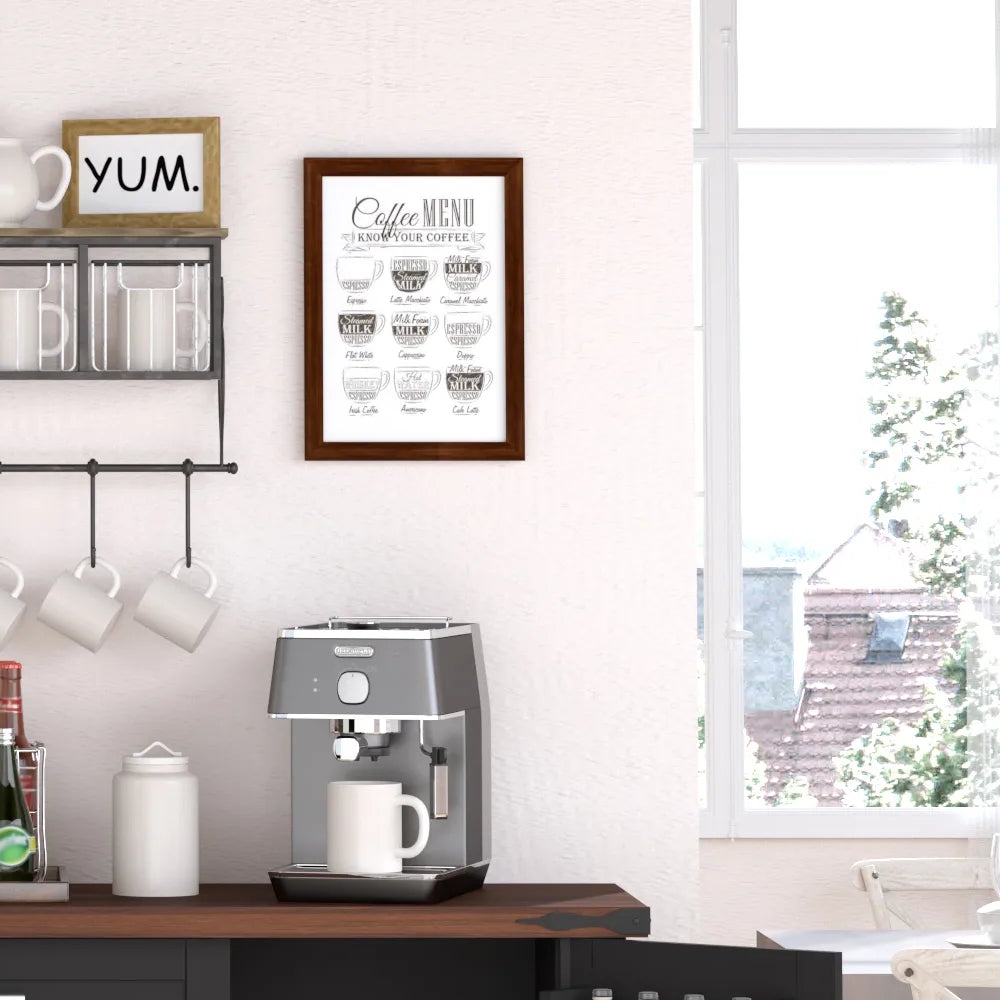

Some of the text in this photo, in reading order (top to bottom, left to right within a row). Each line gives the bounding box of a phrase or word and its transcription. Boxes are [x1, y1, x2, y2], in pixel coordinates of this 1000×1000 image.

[84, 155, 200, 193] YUM.
[352, 196, 475, 239] Coffee MENU
[358, 232, 470, 242] KNOW YOUR COFFEE
[448, 264, 478, 274] MILK
[396, 280, 424, 291] MILK
[394, 313, 411, 324] Milk
[342, 324, 372, 334] MILK
[395, 326, 426, 336] MILK
[447, 323, 481, 335] ESPRESSO
[450, 381, 479, 391] MILK
